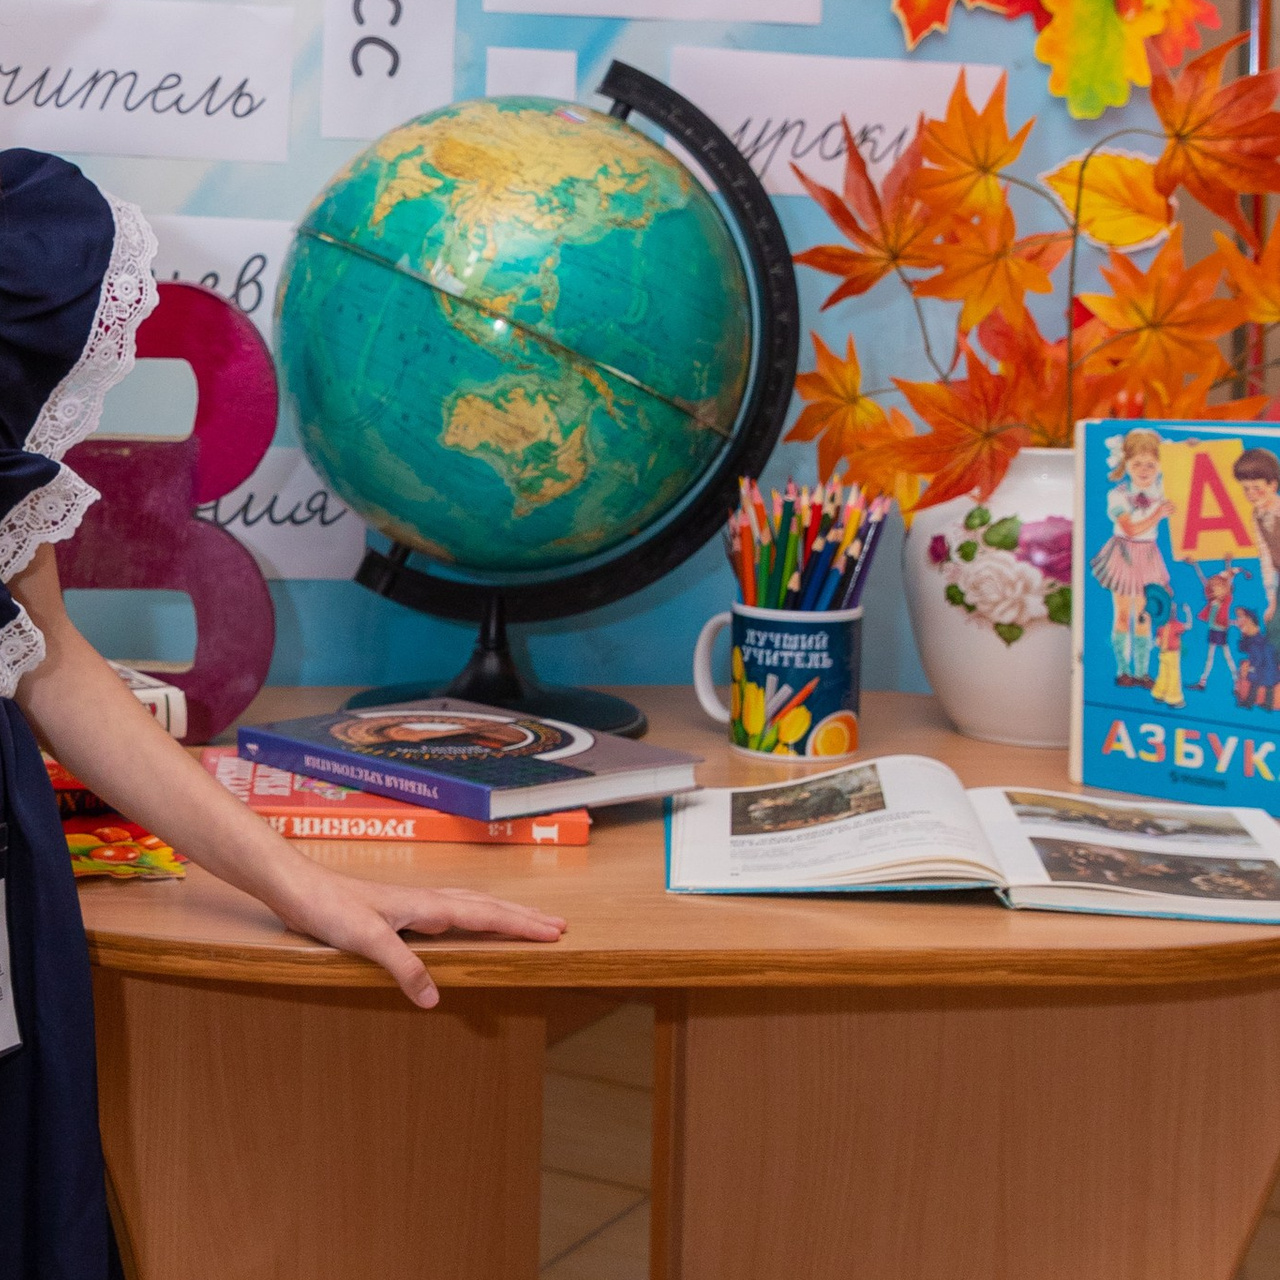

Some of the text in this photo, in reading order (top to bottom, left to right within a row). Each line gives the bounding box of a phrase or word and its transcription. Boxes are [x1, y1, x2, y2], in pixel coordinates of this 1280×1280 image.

[1181, 450, 1255, 551] А
[745, 628, 829, 651] ЛУЧШИЙ
[741, 645, 833, 669] УЧИТЕЛЬ
[1101, 719, 1280, 783] АЗБУК
[385, 775, 439, 800] УЧЕБНАЯ
[291, 814, 417, 839] РУССКИЙ
